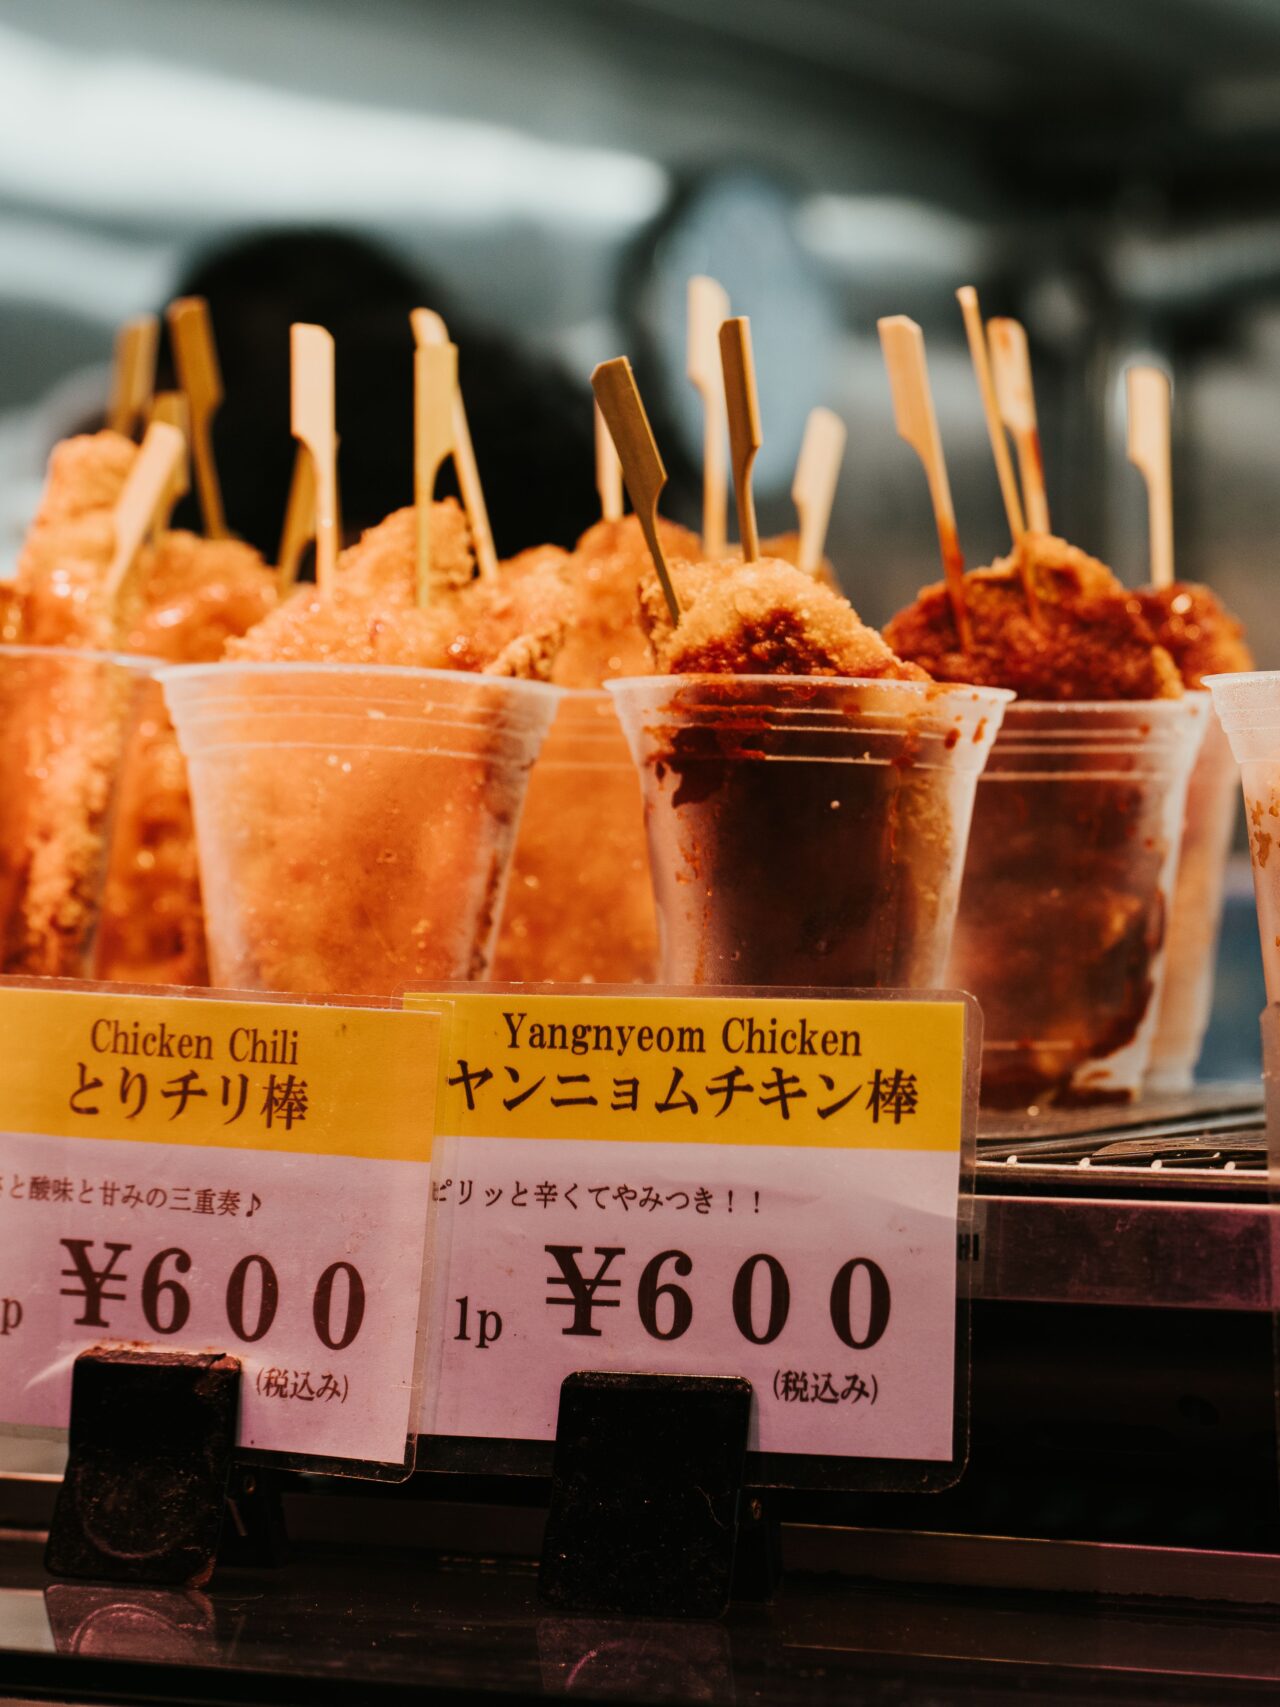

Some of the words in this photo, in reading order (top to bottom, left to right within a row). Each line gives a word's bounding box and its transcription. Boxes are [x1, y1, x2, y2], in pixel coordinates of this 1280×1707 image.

[90, 1018, 213, 1060] Chicken
[228, 1027, 299, 1066] Chili
[502, 1012, 706, 1056] Yangnyeom
[721, 1017, 862, 1057] Chicken
[69, 1061, 309, 1131] とりチリ棒
[447, 1059, 919, 1125] ヤンニョムチキン棒
[59, 1237, 367, 1352] ¥600
[453, 1295, 503, 1349] 1p
[544, 1243, 892, 1351] ¥600
[255, 1367, 350, 1404] (税込み)
[773, 1368, 879, 1405] (税込み)
